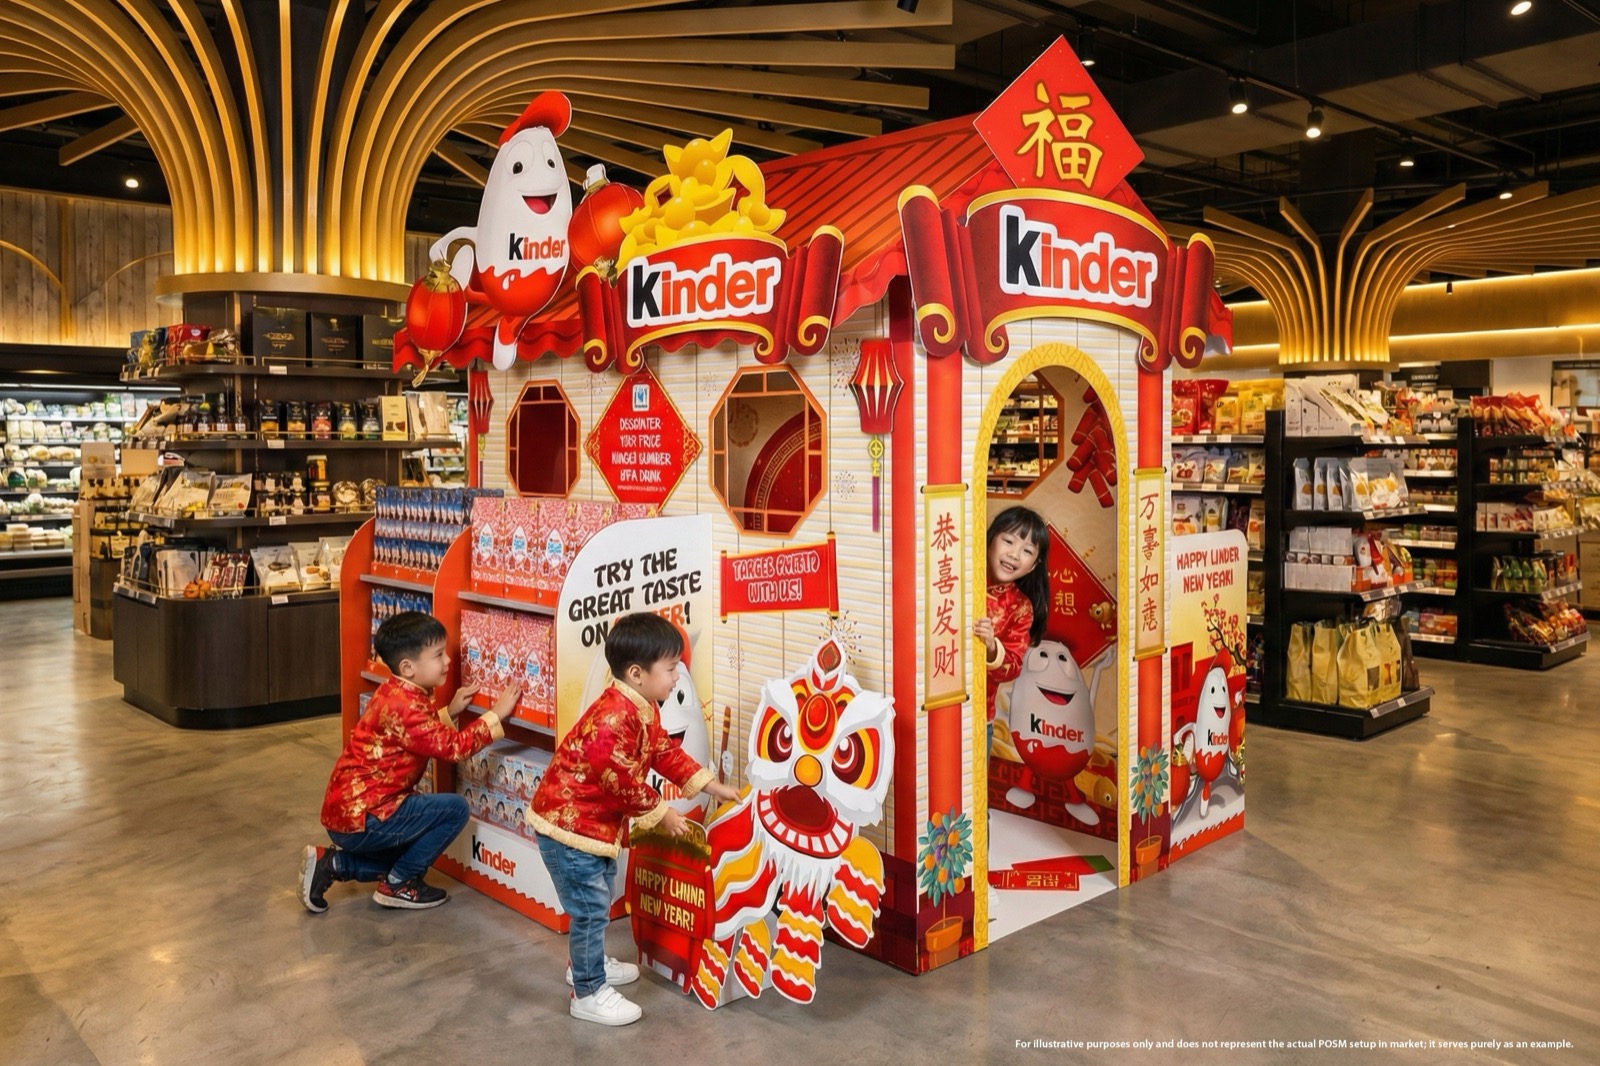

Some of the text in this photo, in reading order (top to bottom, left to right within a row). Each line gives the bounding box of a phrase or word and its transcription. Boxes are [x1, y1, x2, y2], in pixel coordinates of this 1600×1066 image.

[1016, 82, 1104, 190] 福
[593, 547, 678, 589] TRY THE
[1176, 549, 1208, 571] HAPPY
[568, 586, 635, 623] GREAT
[641, 570, 702, 606] TASTE
[930, 512, 960, 679] 恭喜发财
[1183, 572, 1205, 594] NEW
[634, 866, 668, 895] HAPPY
[640, 892, 695, 932] NEW YEAR!
